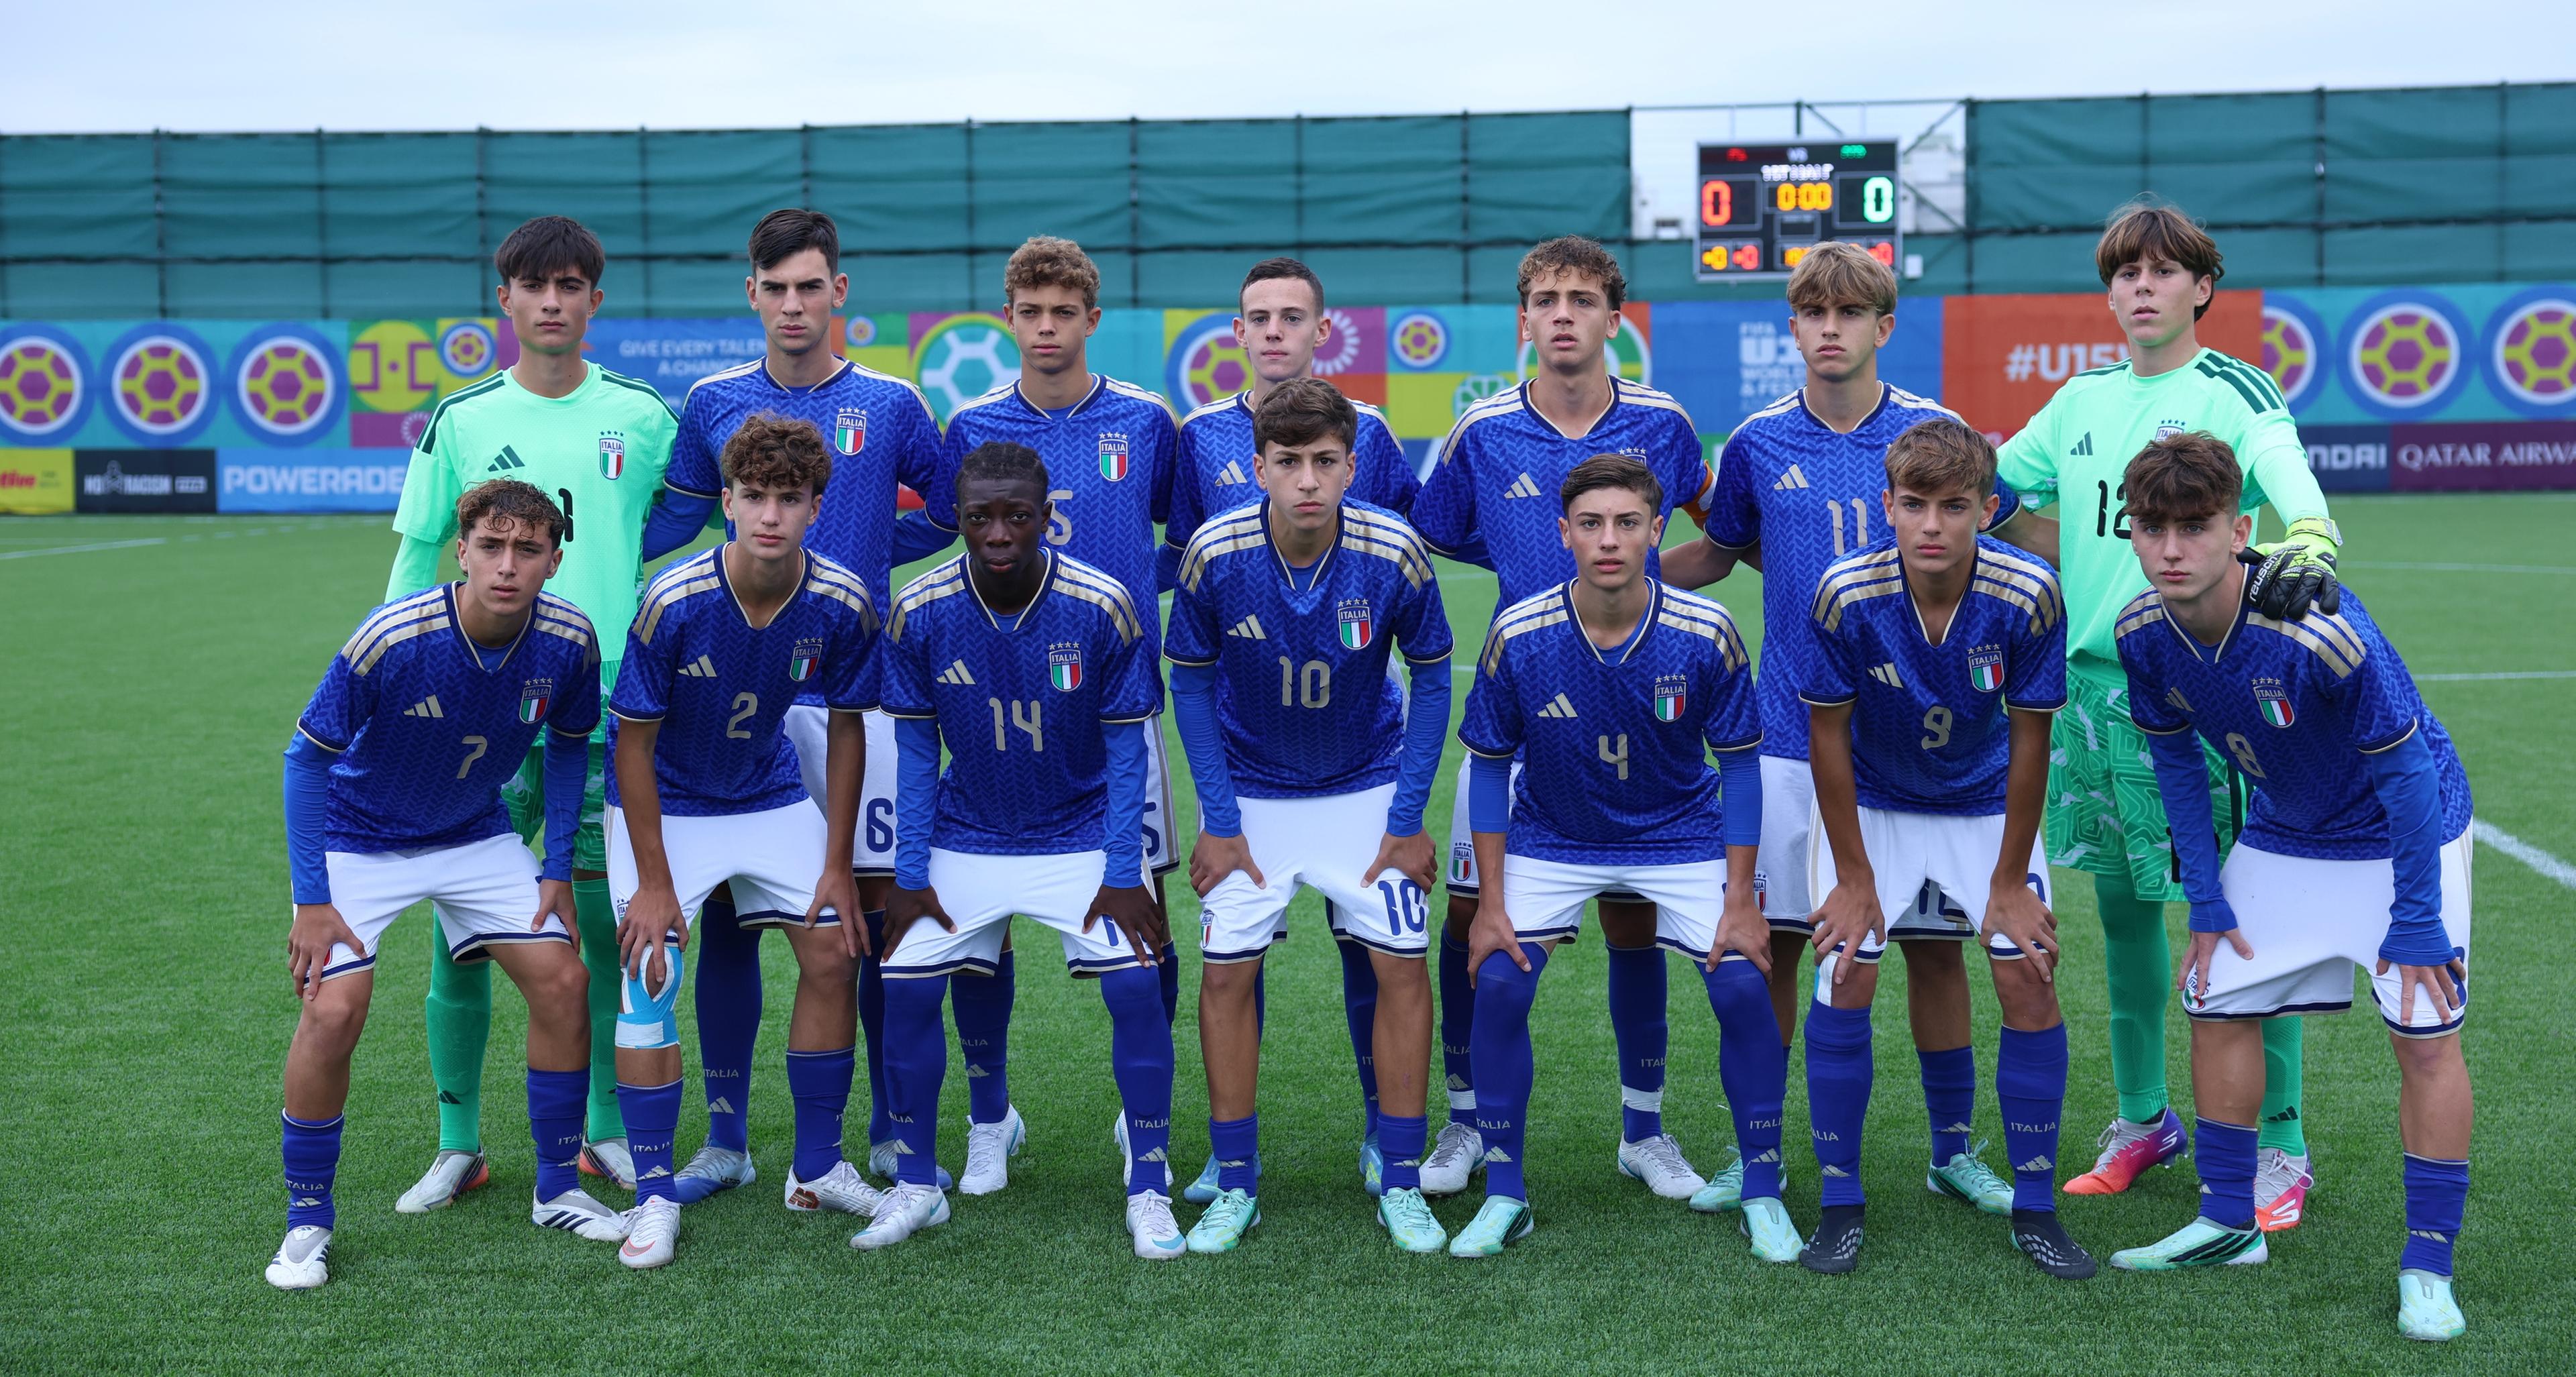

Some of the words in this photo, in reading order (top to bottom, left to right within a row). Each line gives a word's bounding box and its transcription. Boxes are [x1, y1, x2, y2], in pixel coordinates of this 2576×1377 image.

[1702, 180, 1731, 226] 0
[1777, 182, 1832, 211] 0:00
[1864, 176, 1893, 223] 0
[718, 338, 766, 356] TALEN
[839, 417, 863, 428] ITALIA
[601, 441, 623, 451] ITALIA
[1101, 443, 1126, 452] ITALIA
[2308, 443, 2387, 470] NDAI
[2396, 443, 2492, 472] QATAR
[2496, 441, 2576, 466] AIRW
[223, 465, 407, 495] POWERADE
[1044, 490, 1073, 545] 5
[1827, 498, 1868, 557] 11
[2249, 553, 2277, 602] reusch
[1341, 610, 1368, 620] ITALIA
[796, 647, 818, 657] ITALIA
[1052, 653, 1078, 662] ITALIA
[1972, 653, 2000, 666] ITALIA
[1279, 655, 1330, 709] 10
[525, 687, 549, 697] ITALIA
[1658, 685, 1683, 695] ITALIA
[2257, 689, 2284, 698] ITALIA
[726, 692, 757, 738] 2
[989, 697, 1043, 752] 14
[1921, 706, 1953, 750] 9
[457, 735, 488, 779] 7
[1599, 733, 1629, 780] 4
[2225, 732, 2267, 779] 8
[866, 797, 894, 853] 6
[1454, 850, 1470, 858] ITALIA
[1754, 881, 1764, 889] ALIA
[1378, 879, 1425, 936] 10
[960, 1038, 988, 1046] ALIA
[1641, 1057, 1666, 1068] ITAL
[1135, 1118, 1169, 1129] ITALIA
[1477, 1117, 1511, 1130] TALIA
[1750, 1117, 1783, 1130] ITALI
[2011, 1122, 2056, 1133] ITALIA
[558, 1133, 583, 1146] ITAL
[1811, 1128, 1839, 1142] ALIA
[286, 1179, 325, 1191] TALIA
